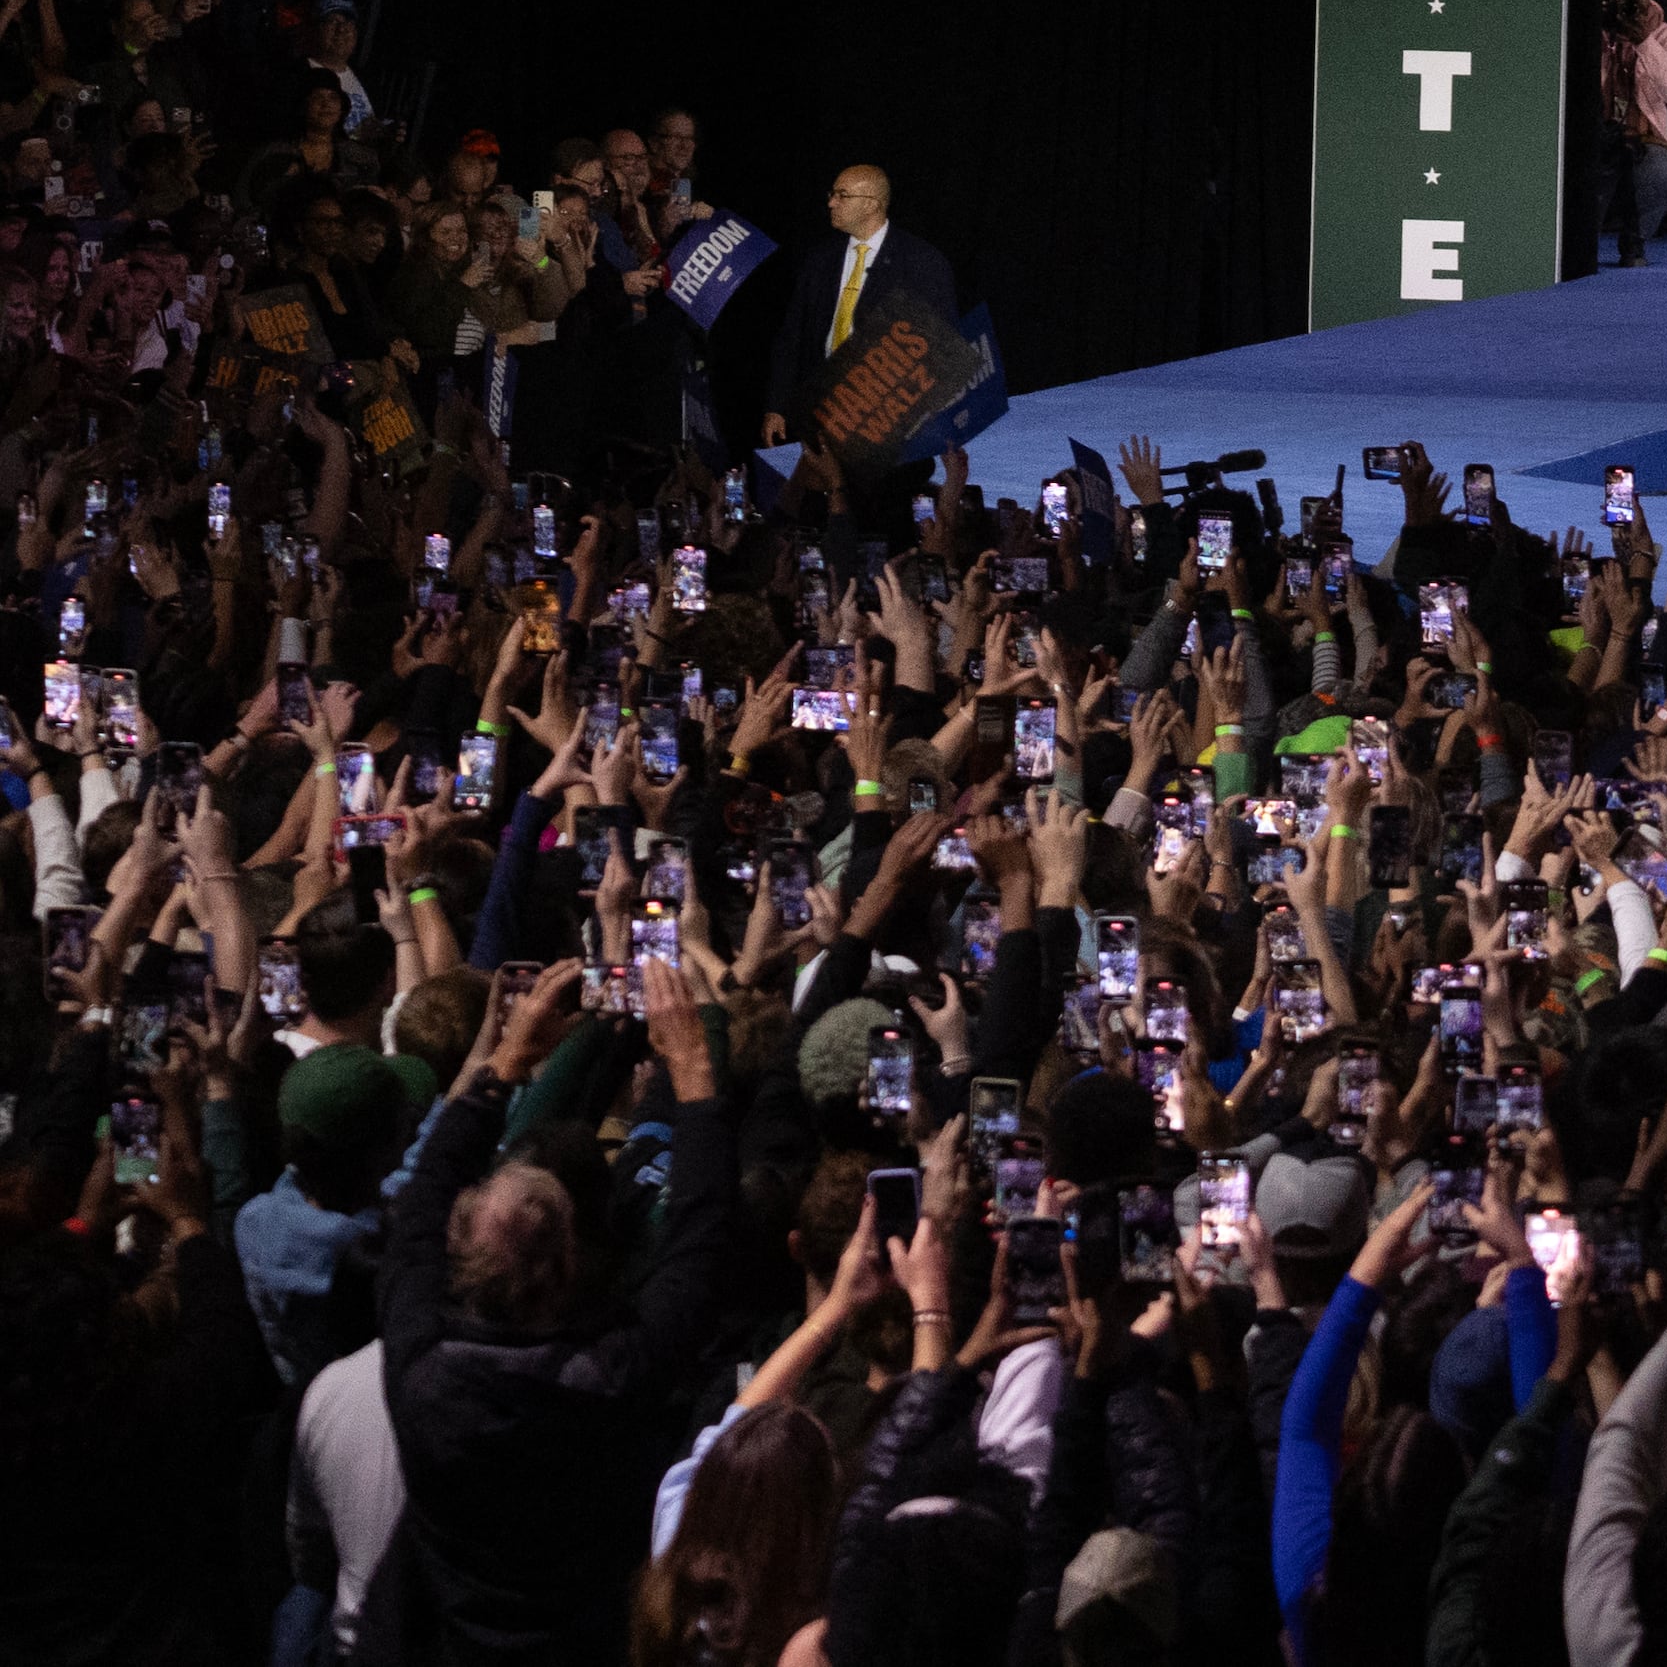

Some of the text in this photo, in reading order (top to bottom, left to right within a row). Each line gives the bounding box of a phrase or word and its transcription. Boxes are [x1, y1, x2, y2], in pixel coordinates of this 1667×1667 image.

[670, 218, 751, 304] FREEDOM
[813, 320, 930, 442] HARRIS
[858, 364, 937, 444] WALZ
